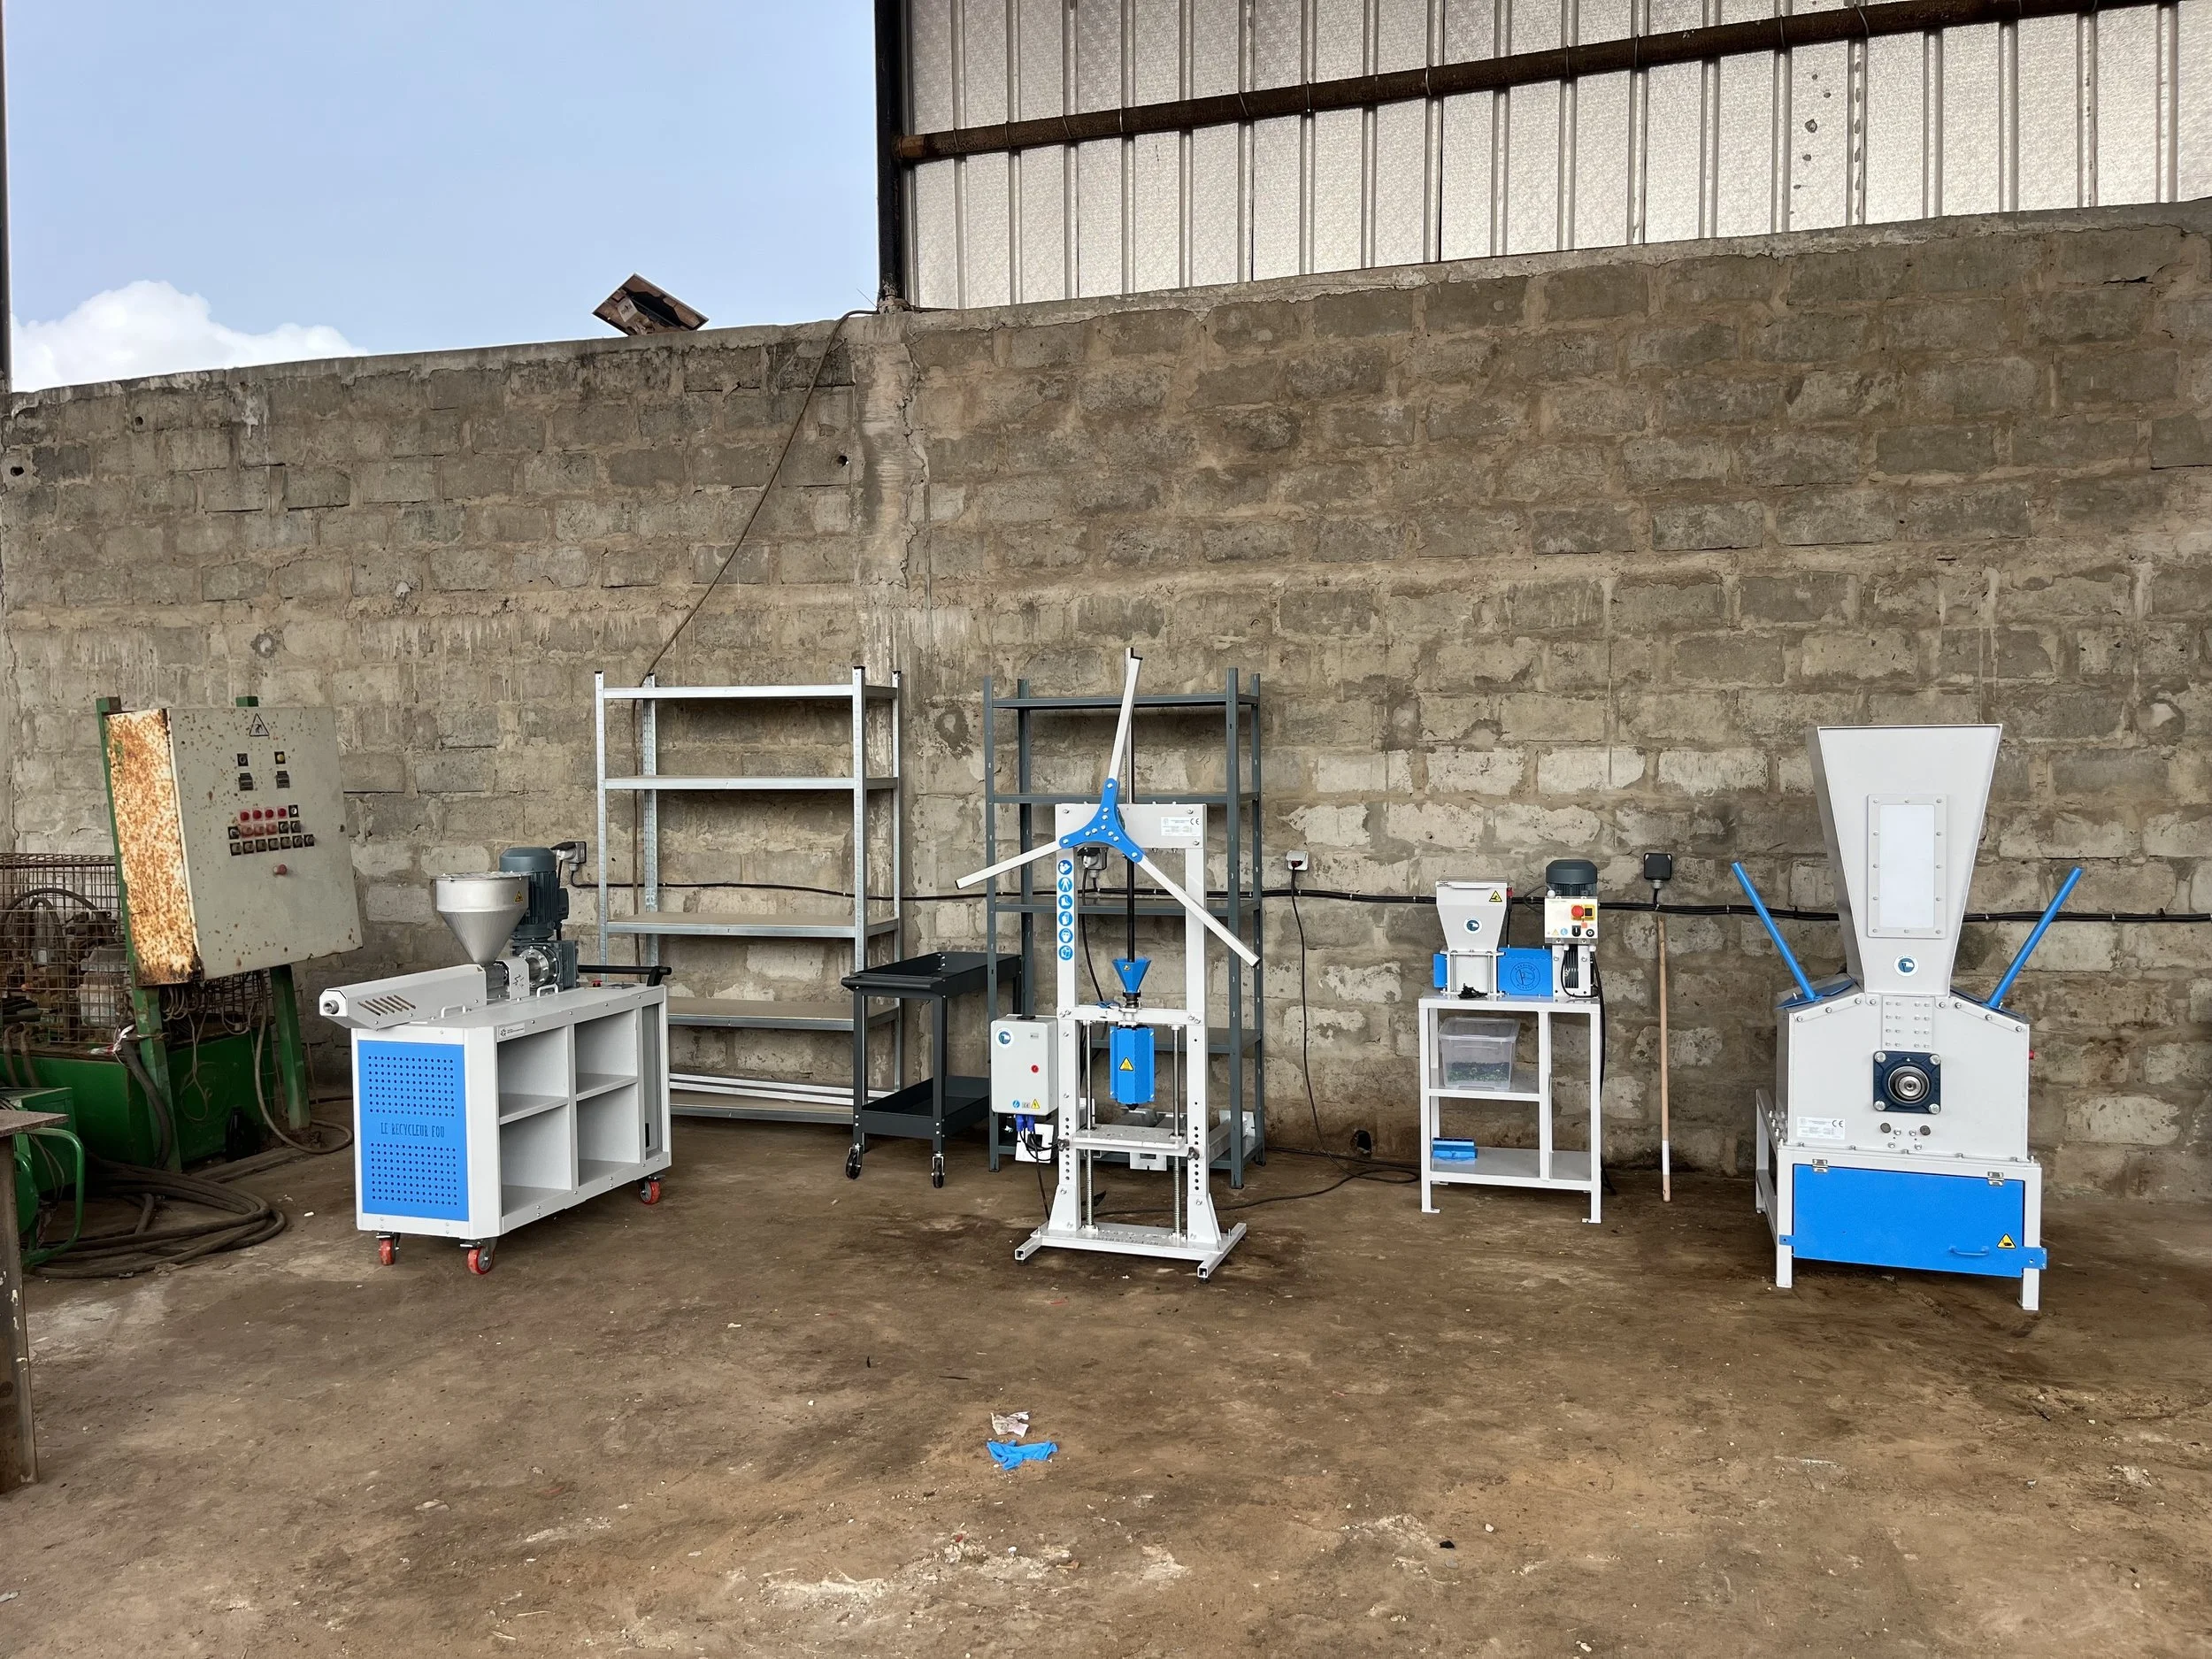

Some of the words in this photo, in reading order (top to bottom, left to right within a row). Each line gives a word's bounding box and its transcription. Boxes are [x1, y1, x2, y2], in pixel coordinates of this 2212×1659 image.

[380, 1122, 388, 1134] LE
[391, 1123, 429, 1137] RECYCLEUR
[431, 1125, 445, 1138] FOU
